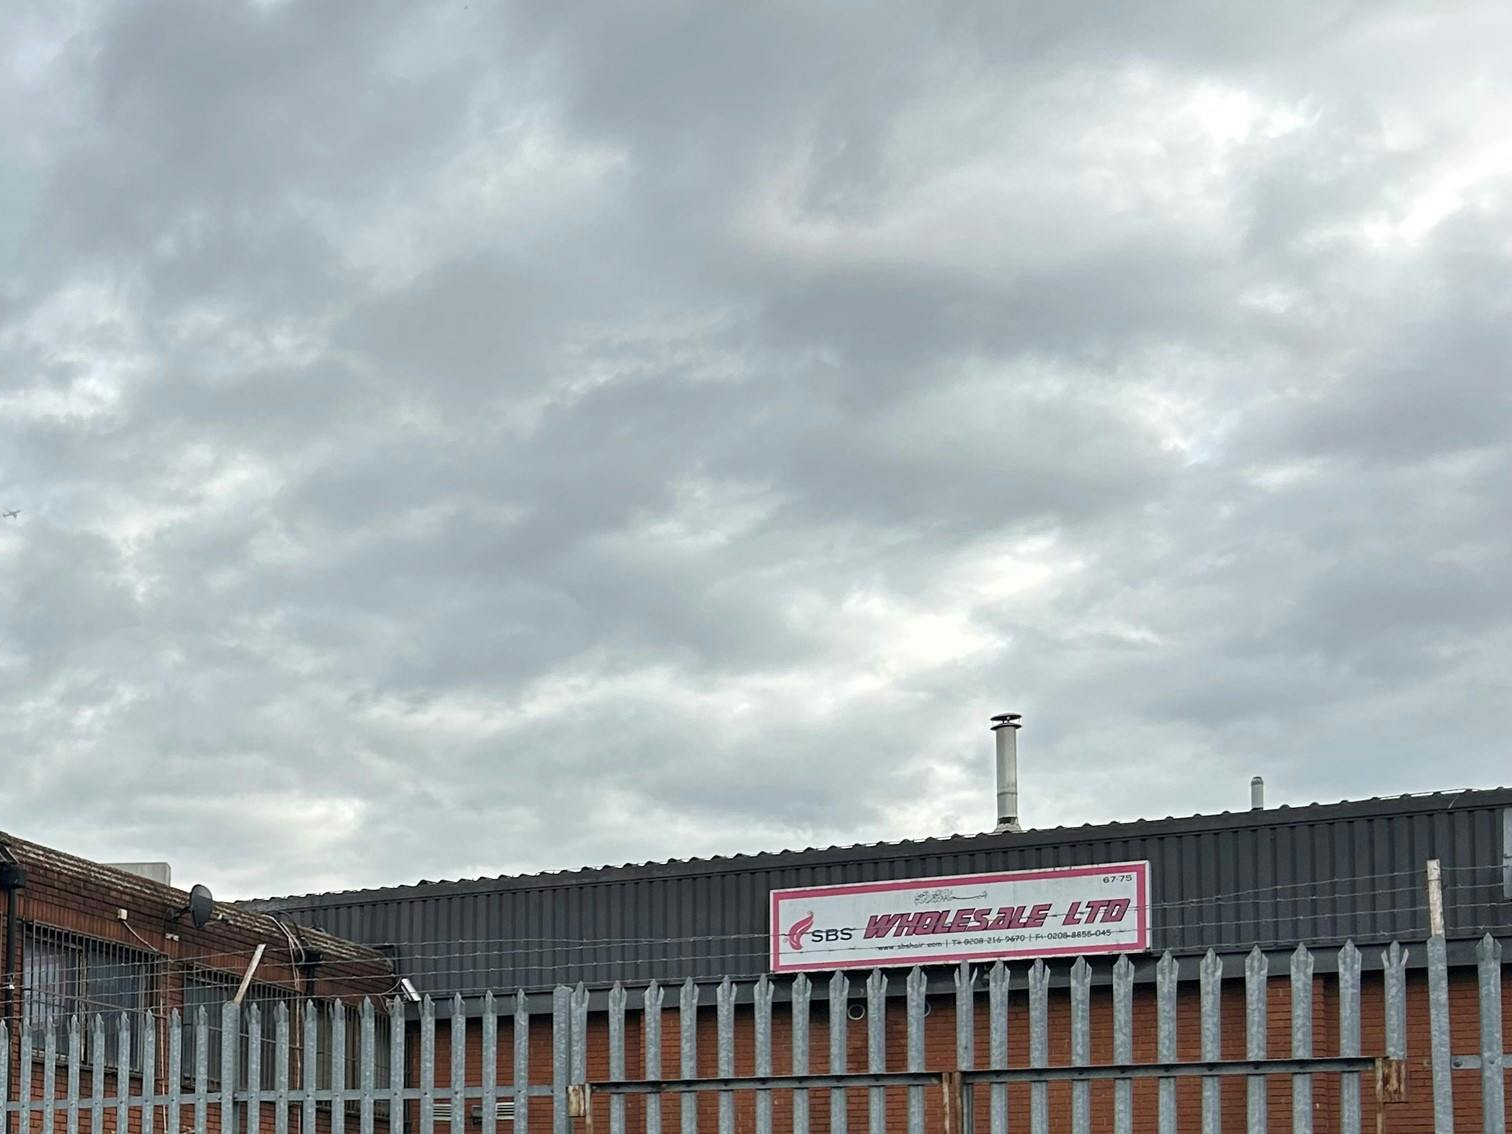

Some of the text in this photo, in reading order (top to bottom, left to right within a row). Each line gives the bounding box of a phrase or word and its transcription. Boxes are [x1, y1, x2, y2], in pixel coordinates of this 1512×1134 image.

[1103, 874, 1133, 884] 67-75
[811, 927, 853, 942] SBS
[1062, 898, 1132, 926] LTD
